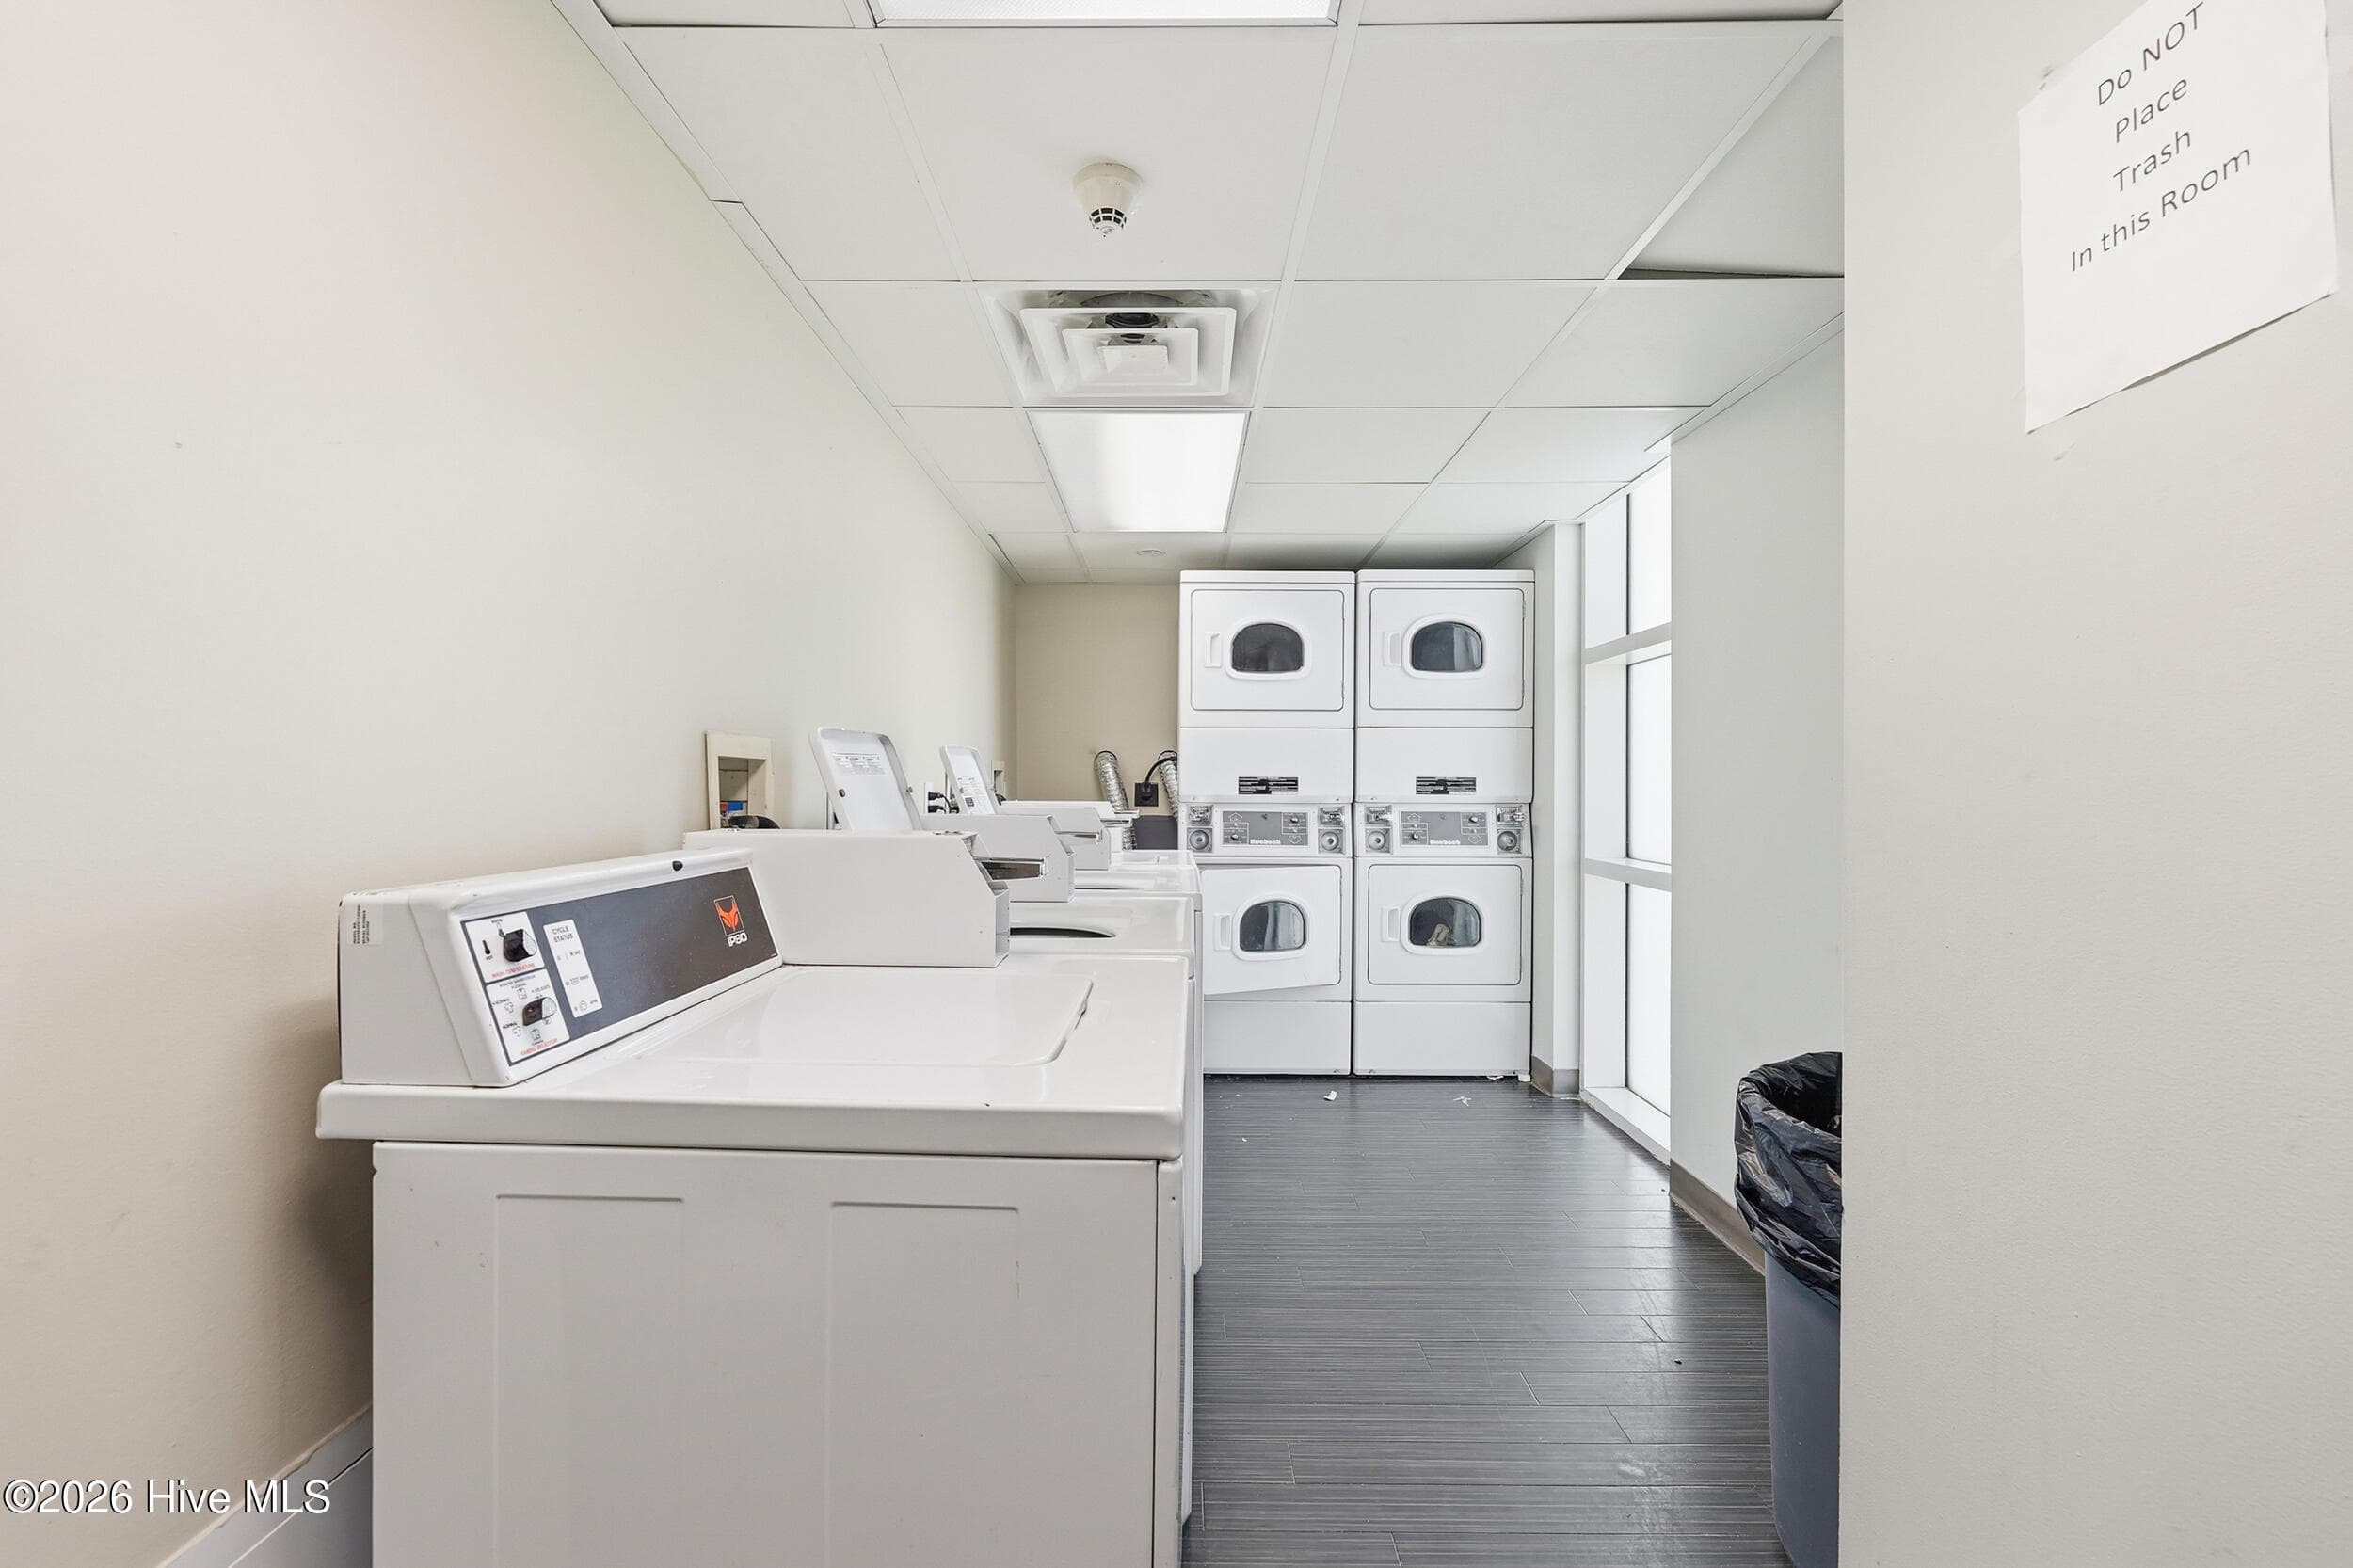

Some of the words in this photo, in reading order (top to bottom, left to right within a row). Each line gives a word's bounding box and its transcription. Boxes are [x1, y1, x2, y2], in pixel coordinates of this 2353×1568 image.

[2097, 69, 2132, 106] Do
[2142, 1, 2204, 71] NOT
[2115, 78, 2187, 143] Place
[2112, 130, 2191, 192] Trash
[2072, 247, 2092, 272] In
[2101, 211, 2151, 252] this
[2161, 149, 2250, 217] Room
[552, 925, 569, 935] CYCLE
[553, 933, 573, 943] STATUS
